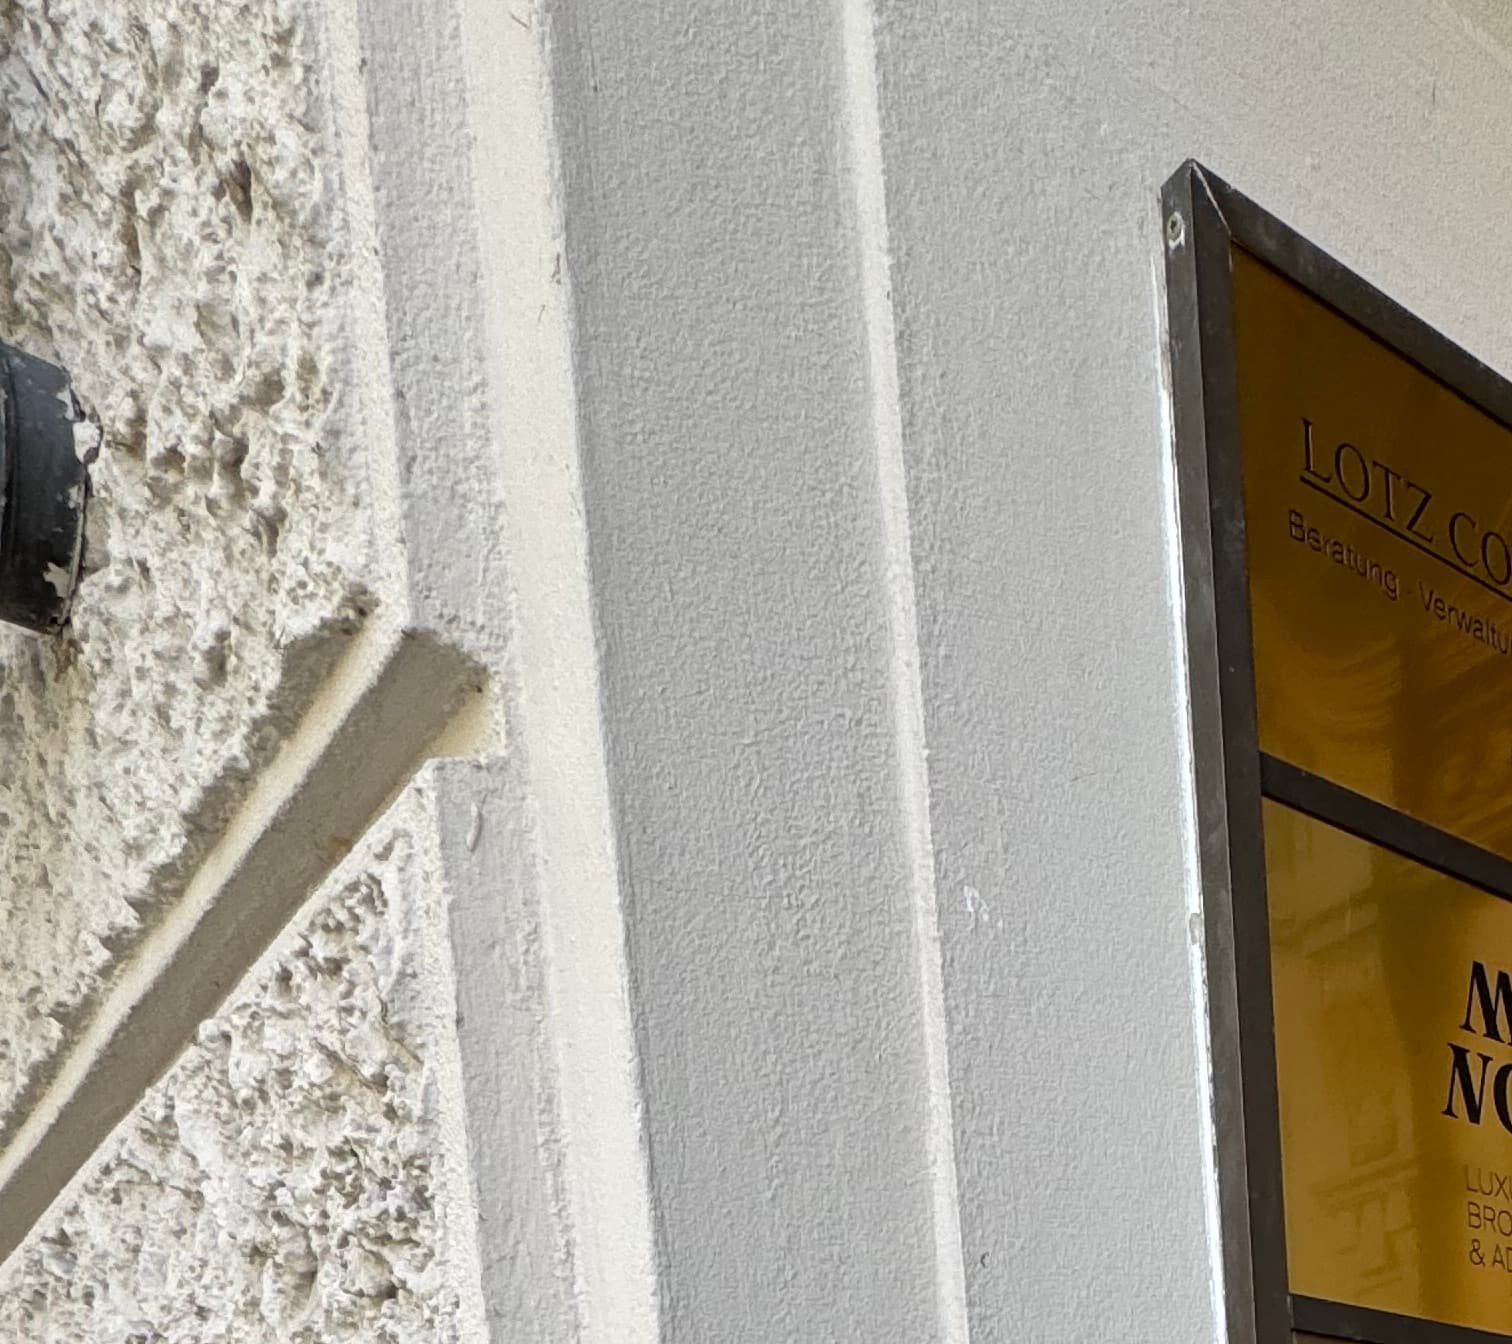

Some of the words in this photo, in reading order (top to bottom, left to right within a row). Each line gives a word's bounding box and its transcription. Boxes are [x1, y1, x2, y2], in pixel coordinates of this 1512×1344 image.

[1302, 418, 1434, 544] LOTZ
[1288, 508, 1400, 599] Beratung
[1469, 1238, 1487, 1266] &
